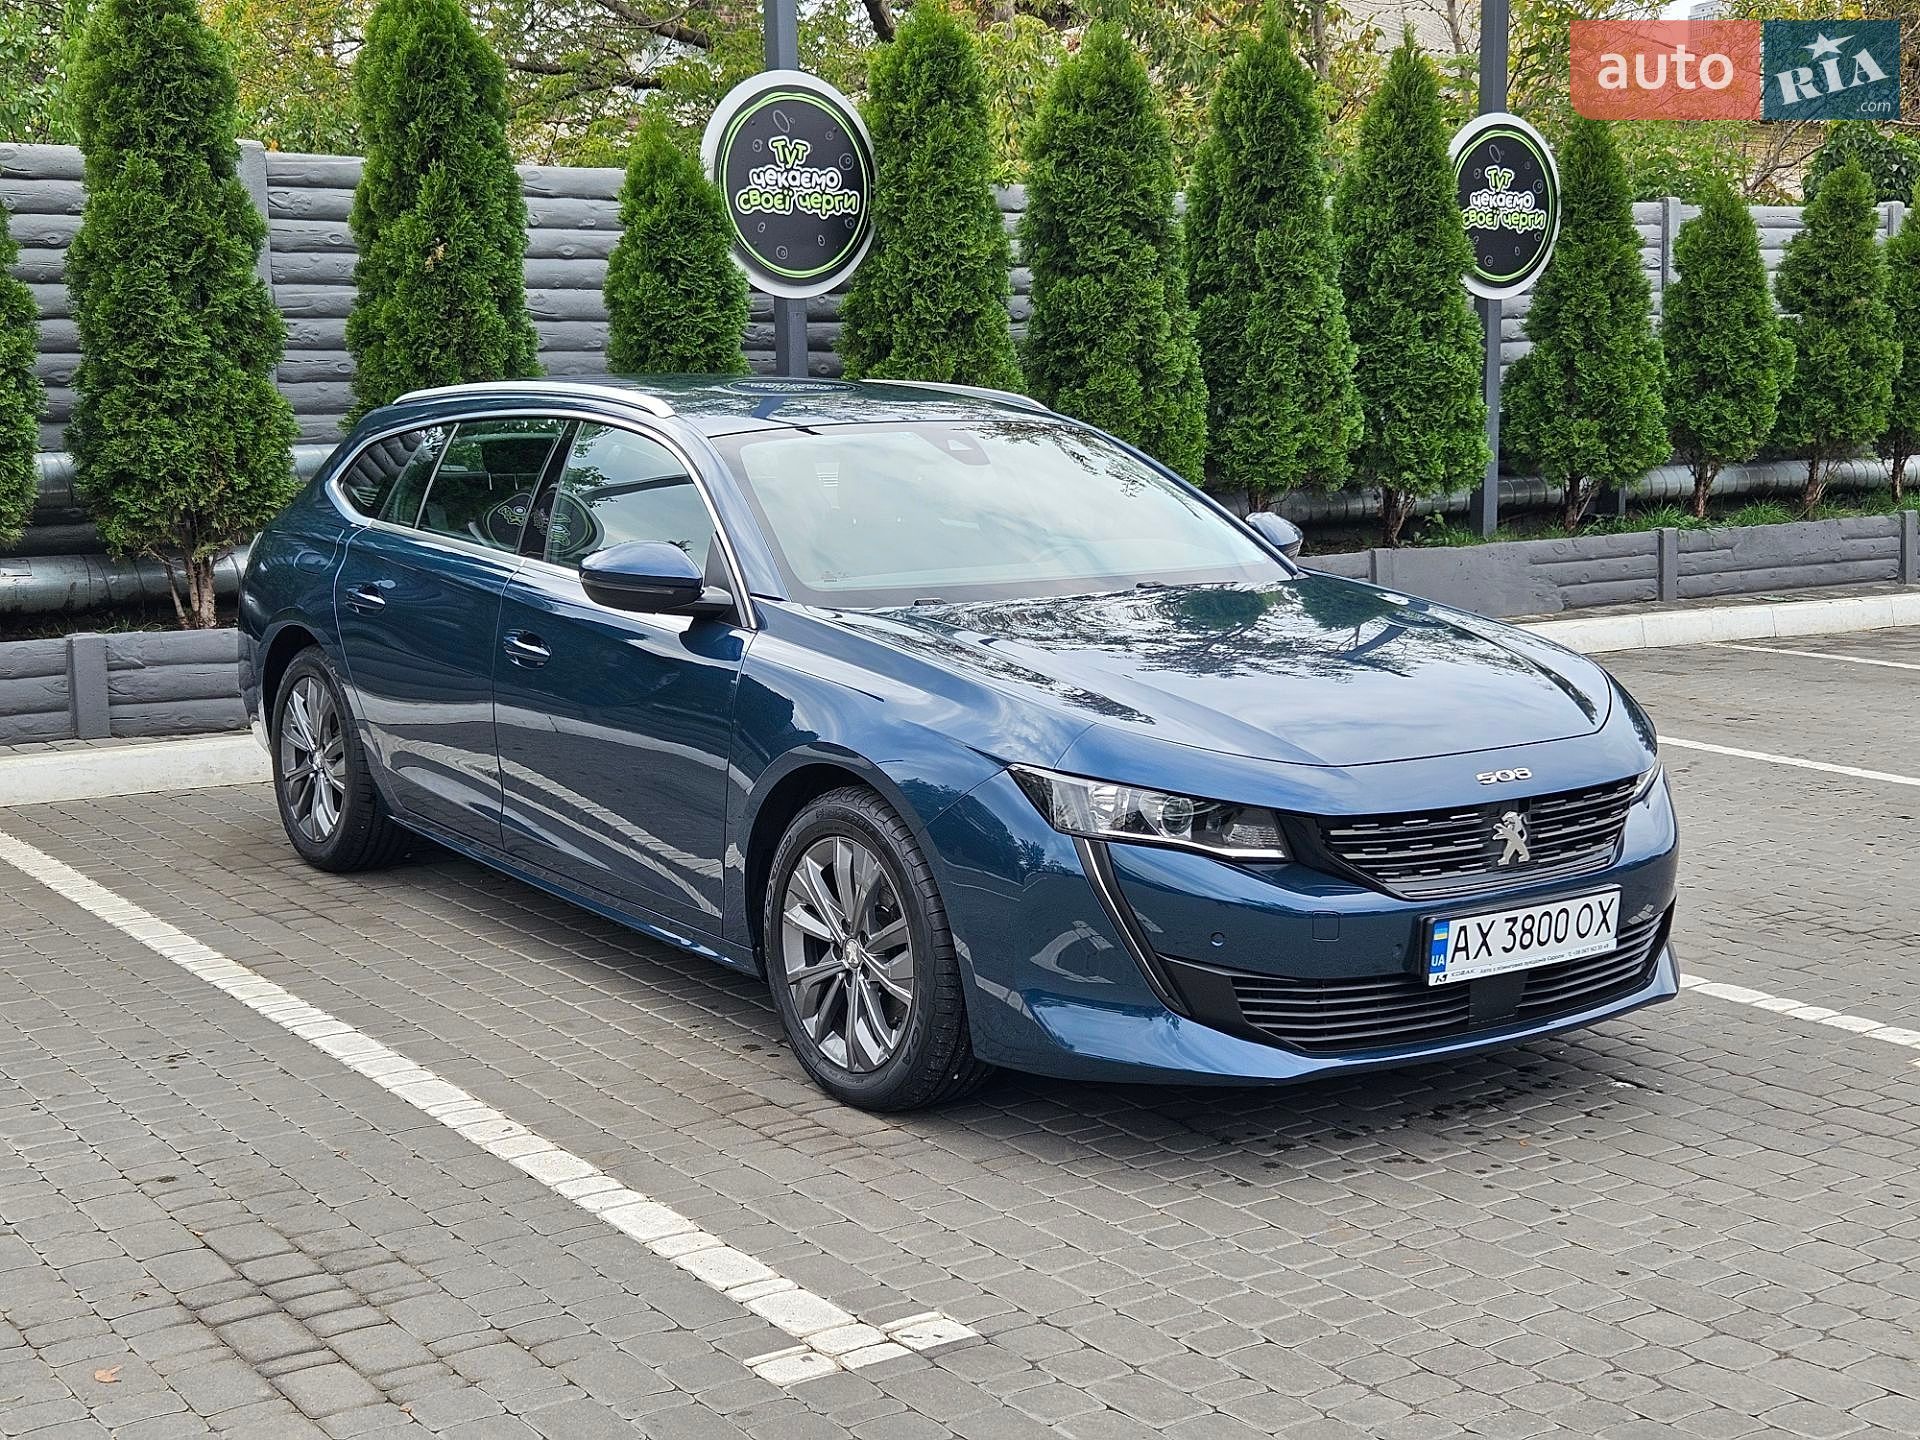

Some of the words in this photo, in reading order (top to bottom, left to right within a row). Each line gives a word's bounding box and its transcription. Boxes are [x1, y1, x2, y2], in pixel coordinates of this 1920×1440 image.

[770, 137, 810, 168] Тут
[750, 168, 840, 190] чекаємо
[1486, 167, 1513, 191] Тут
[737, 189, 794, 213] своєї
[797, 191, 859, 218] черги
[1470, 192, 1534, 210] чекаємо
[1502, 211, 1546, 232] черги
[1476, 767, 1533, 785] 508
[1449, 919, 1497, 964] AX
[1501, 907, 1570, 954] 3800
[1575, 897, 1615, 939] OX
[1431, 954, 1445, 967] UA
